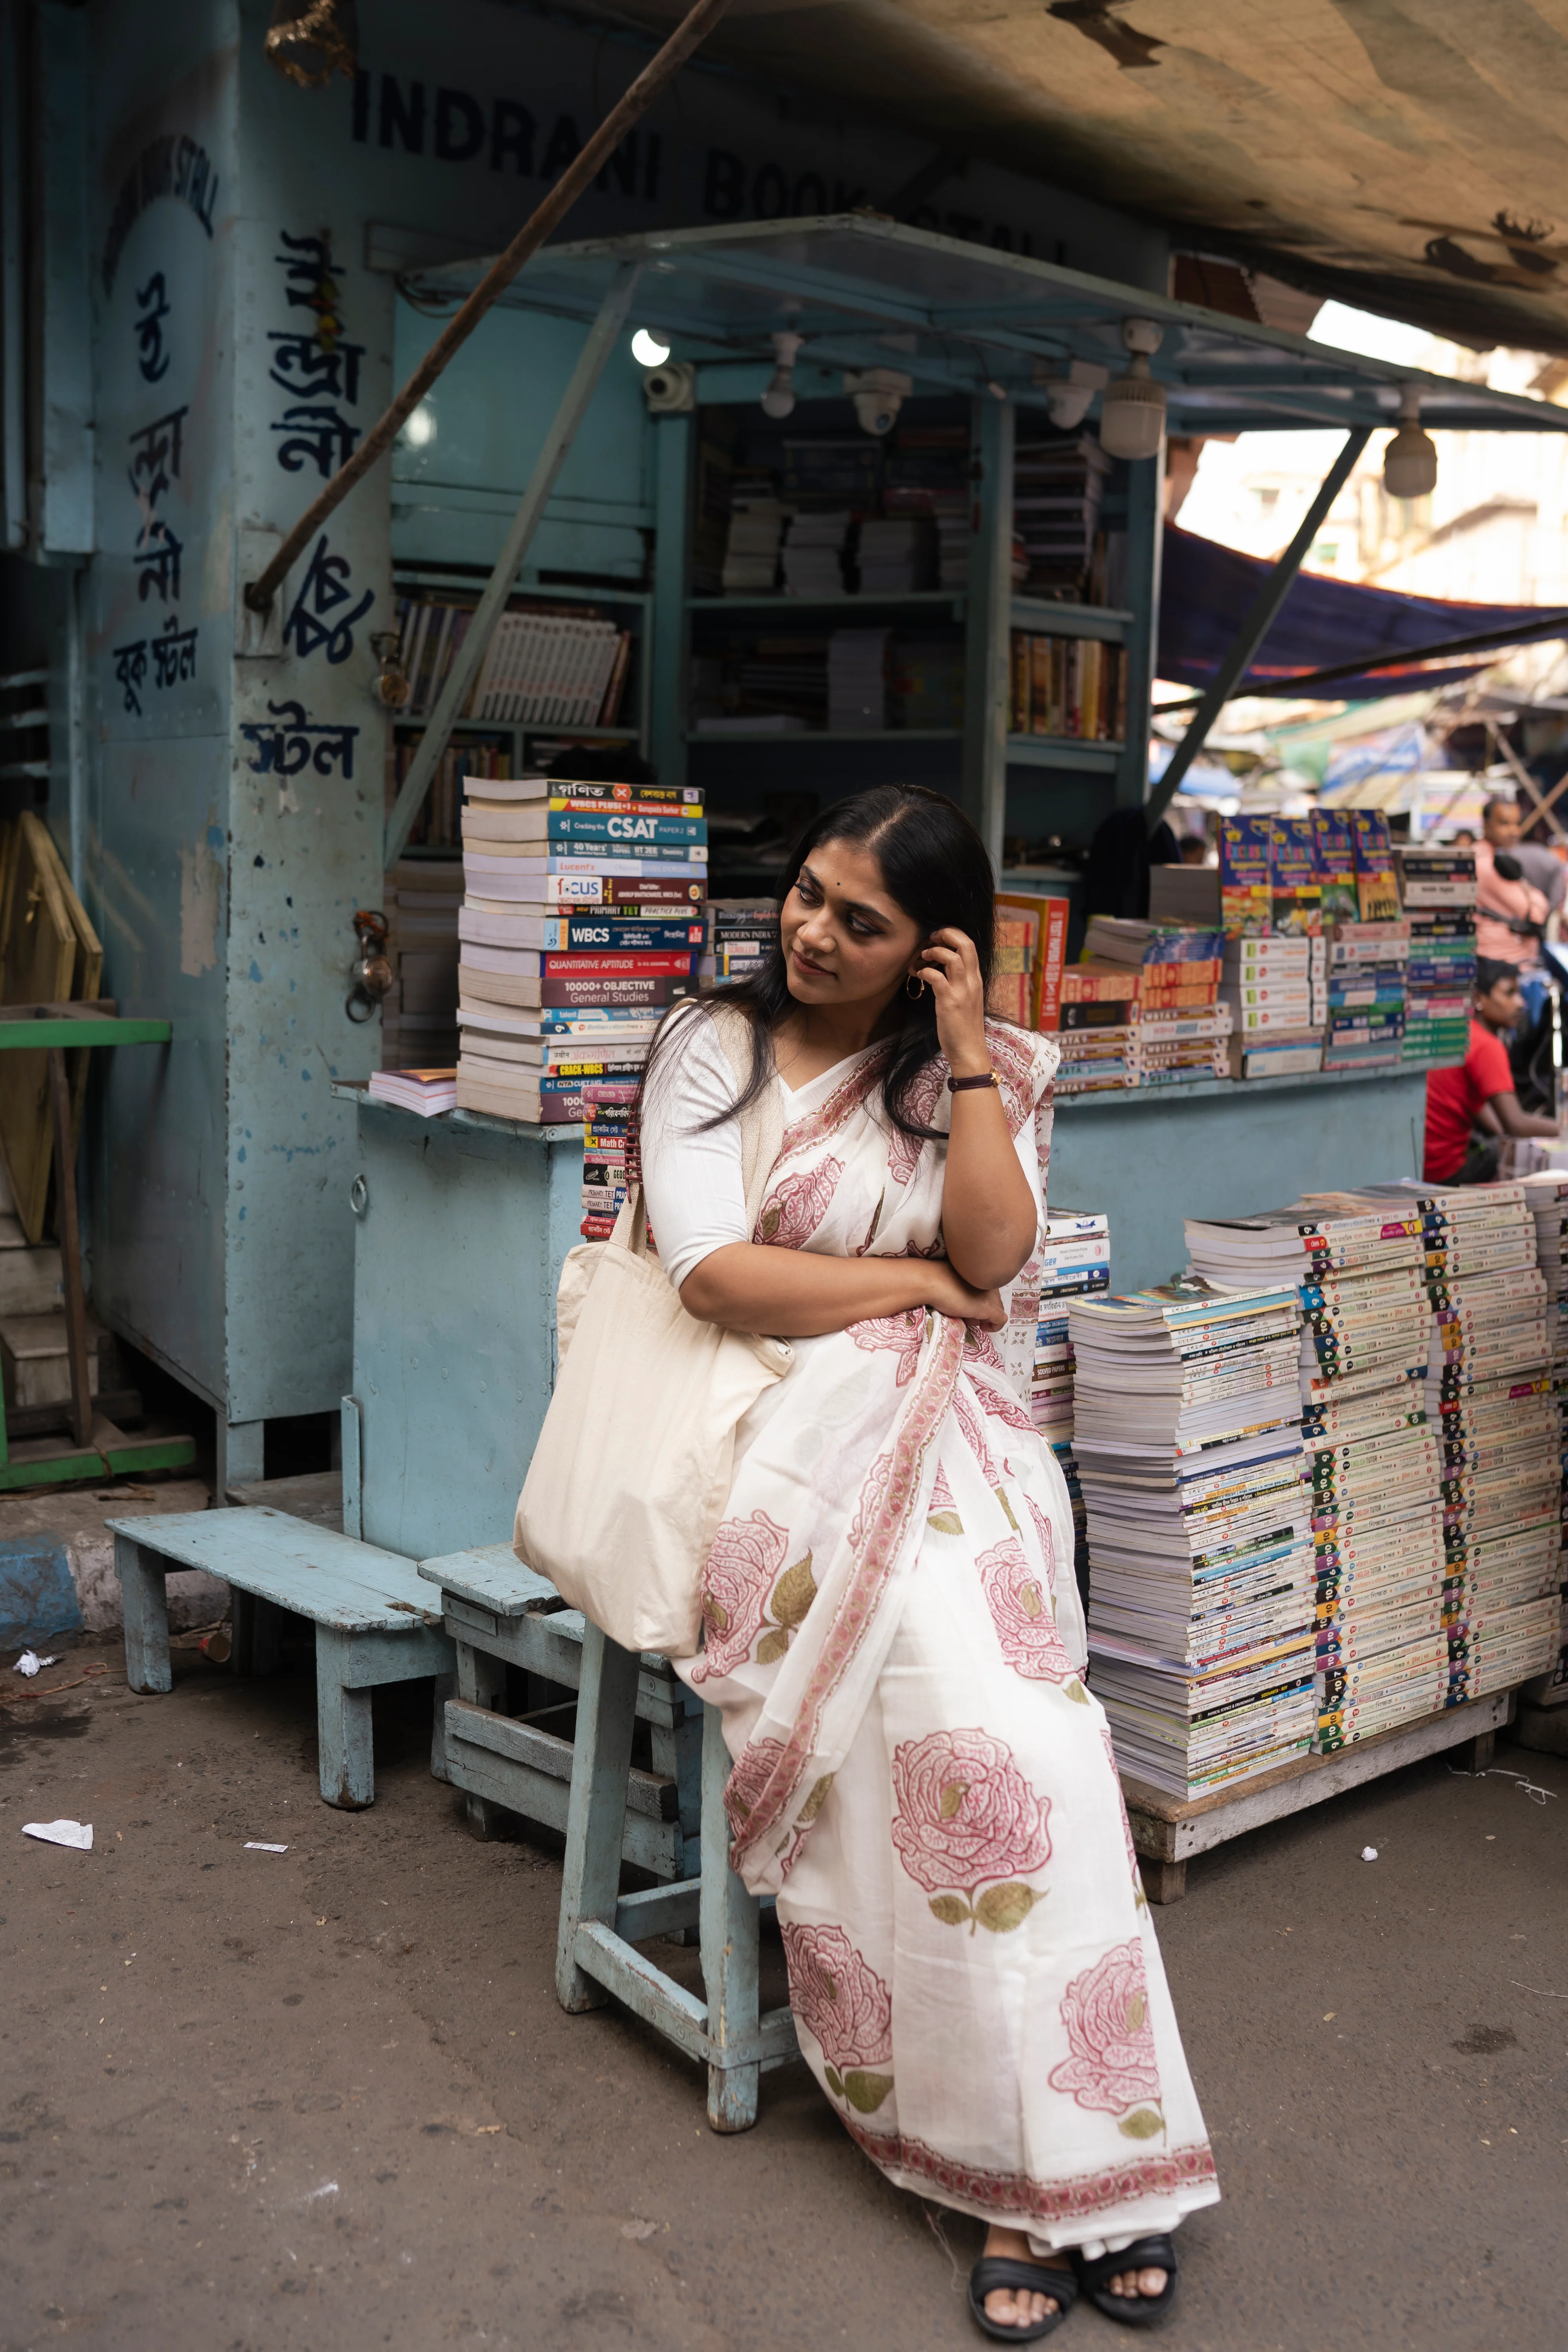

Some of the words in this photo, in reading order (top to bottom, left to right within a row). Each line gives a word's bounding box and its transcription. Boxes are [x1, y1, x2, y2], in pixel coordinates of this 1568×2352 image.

[558, 784, 606, 797] গণিত
[570, 800, 597, 808] WBCS
[574, 822, 597, 831] Cracking
[607, 817, 658, 839] CSAT
[573, 842, 584, 851] 40
[585, 842, 607, 851] Years'
[560, 862, 595, 871] Lucent's
[590, 906, 621, 915] PRIMARY
[623, 906, 639, 915] TET
[572, 927, 610, 943] WBCS
[720, 930, 751, 939] MODERN
[751, 931, 772, 939] INDIA
[549, 959, 600, 969] QUANTITATIVE
[601, 959, 634, 969] APTITUDE
[564, 981, 601, 992] 10000+
[603, 980, 655, 991] OBJECTIVE
[570, 992, 610, 1003] General
[612, 992, 649, 1002] Studies
[554, 1050, 570, 1058] नवीन
[570, 1047, 615, 1061] अंकगणित
[559, 1063, 603, 1076] CRACK-WBCS
[562, 1097, 585, 1107] 1000
[600, 1138, 617, 1148] Math
[616, 1191, 627, 1200] PRAC
[614, 1202, 623, 1210] PRA
[1460, 1265, 1473, 1274] ENGLISH
[1340, 1305, 1356, 1314] ENGLISH
[1356, 1302, 1368, 1310] TUTOR
[1320, 1321, 1327, 1333] 10
[1352, 1344, 1366, 1353] ENGLISH
[1366, 1341, 1377, 1350] TUTOR
[1037, 1367, 1052, 1376] SOLVED
[1052, 1364, 1065, 1372] PAPERS
[1350, 1445, 1365, 1454] ENGLISH
[1365, 1441, 1376, 1451] TUTOR
[1323, 1491, 1330, 1503] 10
[1354, 1508, 1369, 1518] ENGLISH
[1370, 1504, 1381, 1514] TUTOR
[1481, 1543, 1495, 1553] ENGLISH
[1495, 1541, 1506, 1550] TUTOR
[1355, 1570, 1370, 1579] ENGLISH
[1370, 1565, 1381, 1574] TUTOR
[1482, 1651, 1496, 1662] ENGLISH
[1496, 1648, 1507, 1657] TUTOR
[1261, 1689, 1279, 1699] SIDDHANTA
[1356, 1694, 1372, 1704] ENGLISH
[1372, 1690, 1383, 1699] TUTOR
[1207, 1709, 1220, 1717] PHYSICAL
[1235, 1697, 1255, 1707] ENVIRONMENT
[1361, 1727, 1376, 1738] ENGLISH
[1375, 1722, 1387, 1732] TUTOR
